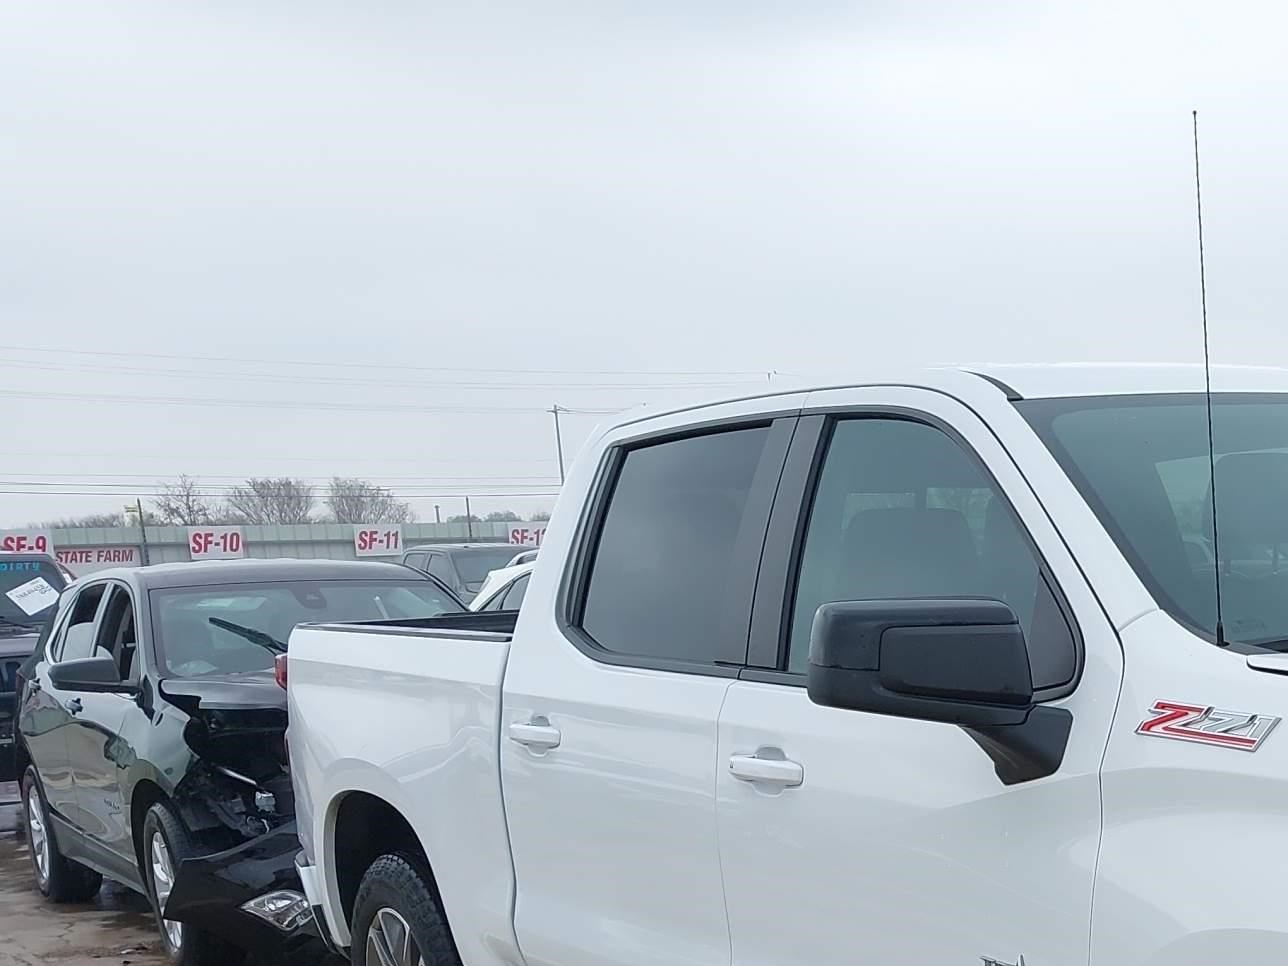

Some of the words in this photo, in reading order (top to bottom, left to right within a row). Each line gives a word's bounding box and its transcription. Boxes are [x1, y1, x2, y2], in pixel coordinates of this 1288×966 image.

[3, 536, 47, 552] SF-9
[192, 532, 240, 553] SF-10
[358, 530, 399, 550] SF-11
[56, 551, 93, 563] STATE
[97, 549, 134, 562] FARM
[1134, 699, 1282, 752] Z71
